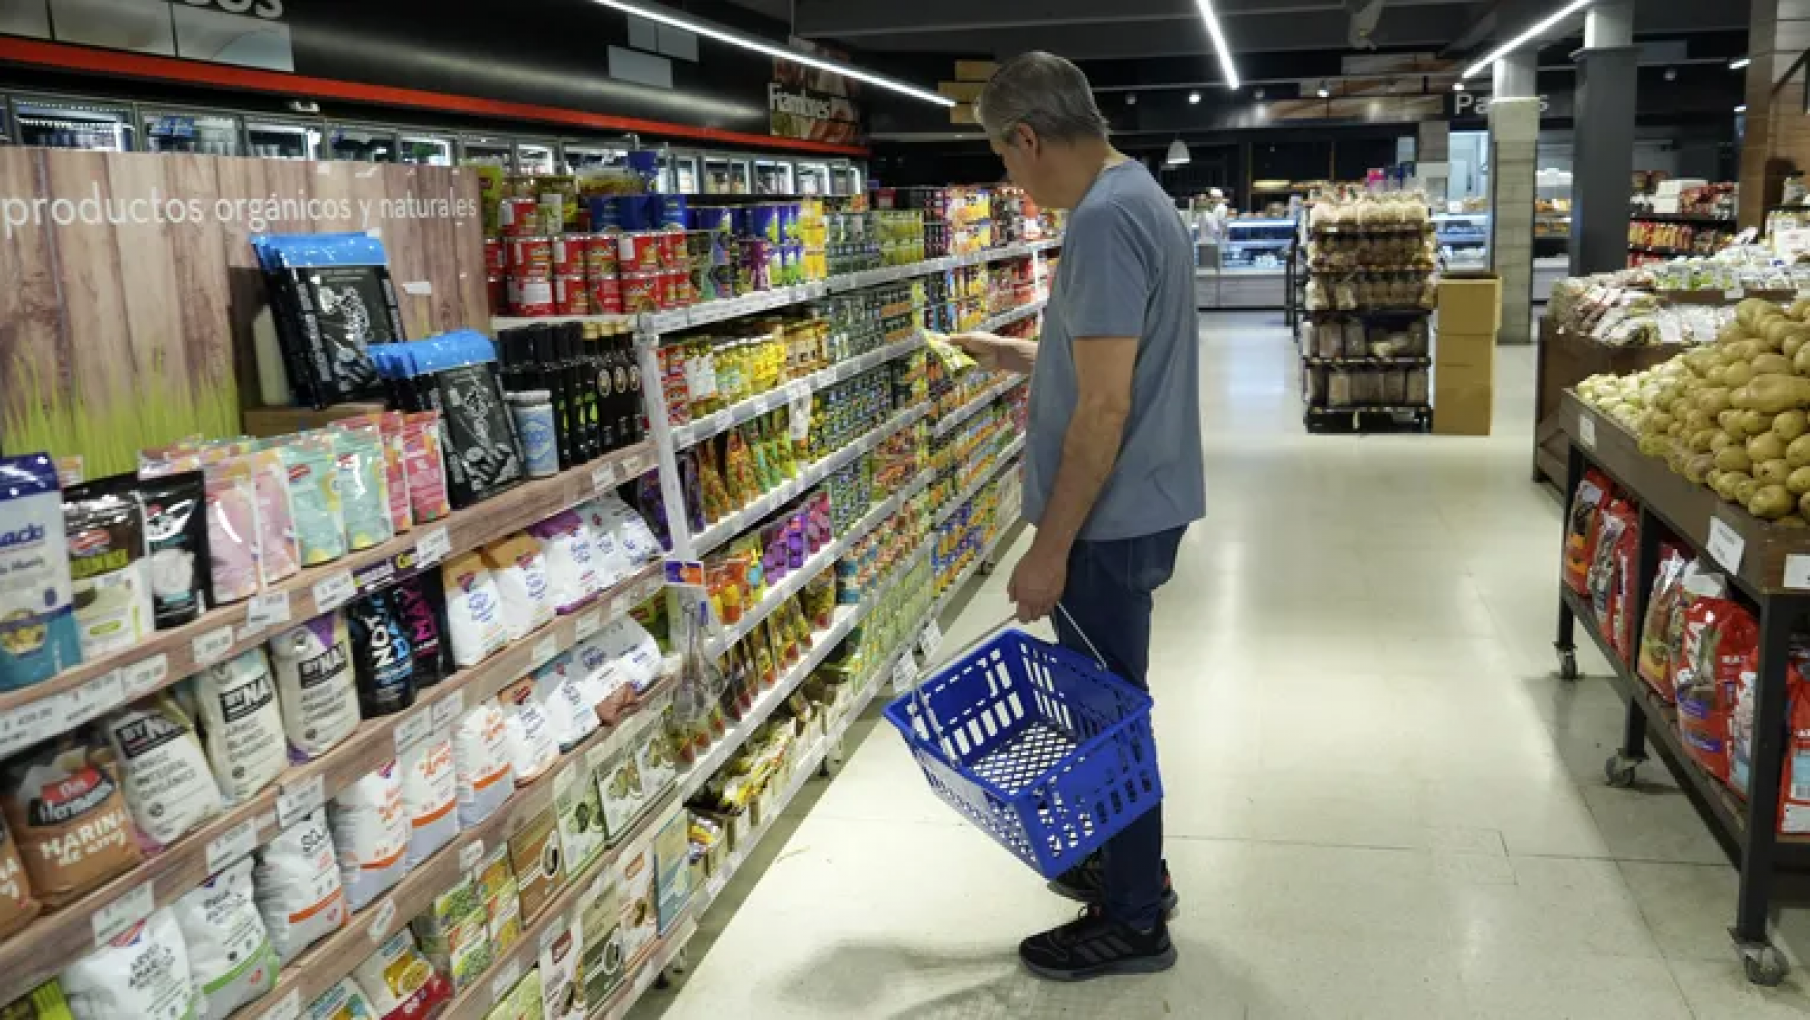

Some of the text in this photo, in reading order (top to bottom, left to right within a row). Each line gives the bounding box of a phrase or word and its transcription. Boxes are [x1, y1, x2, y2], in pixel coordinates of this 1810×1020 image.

[2, 181, 478, 240] productos orgánicos y naturales
